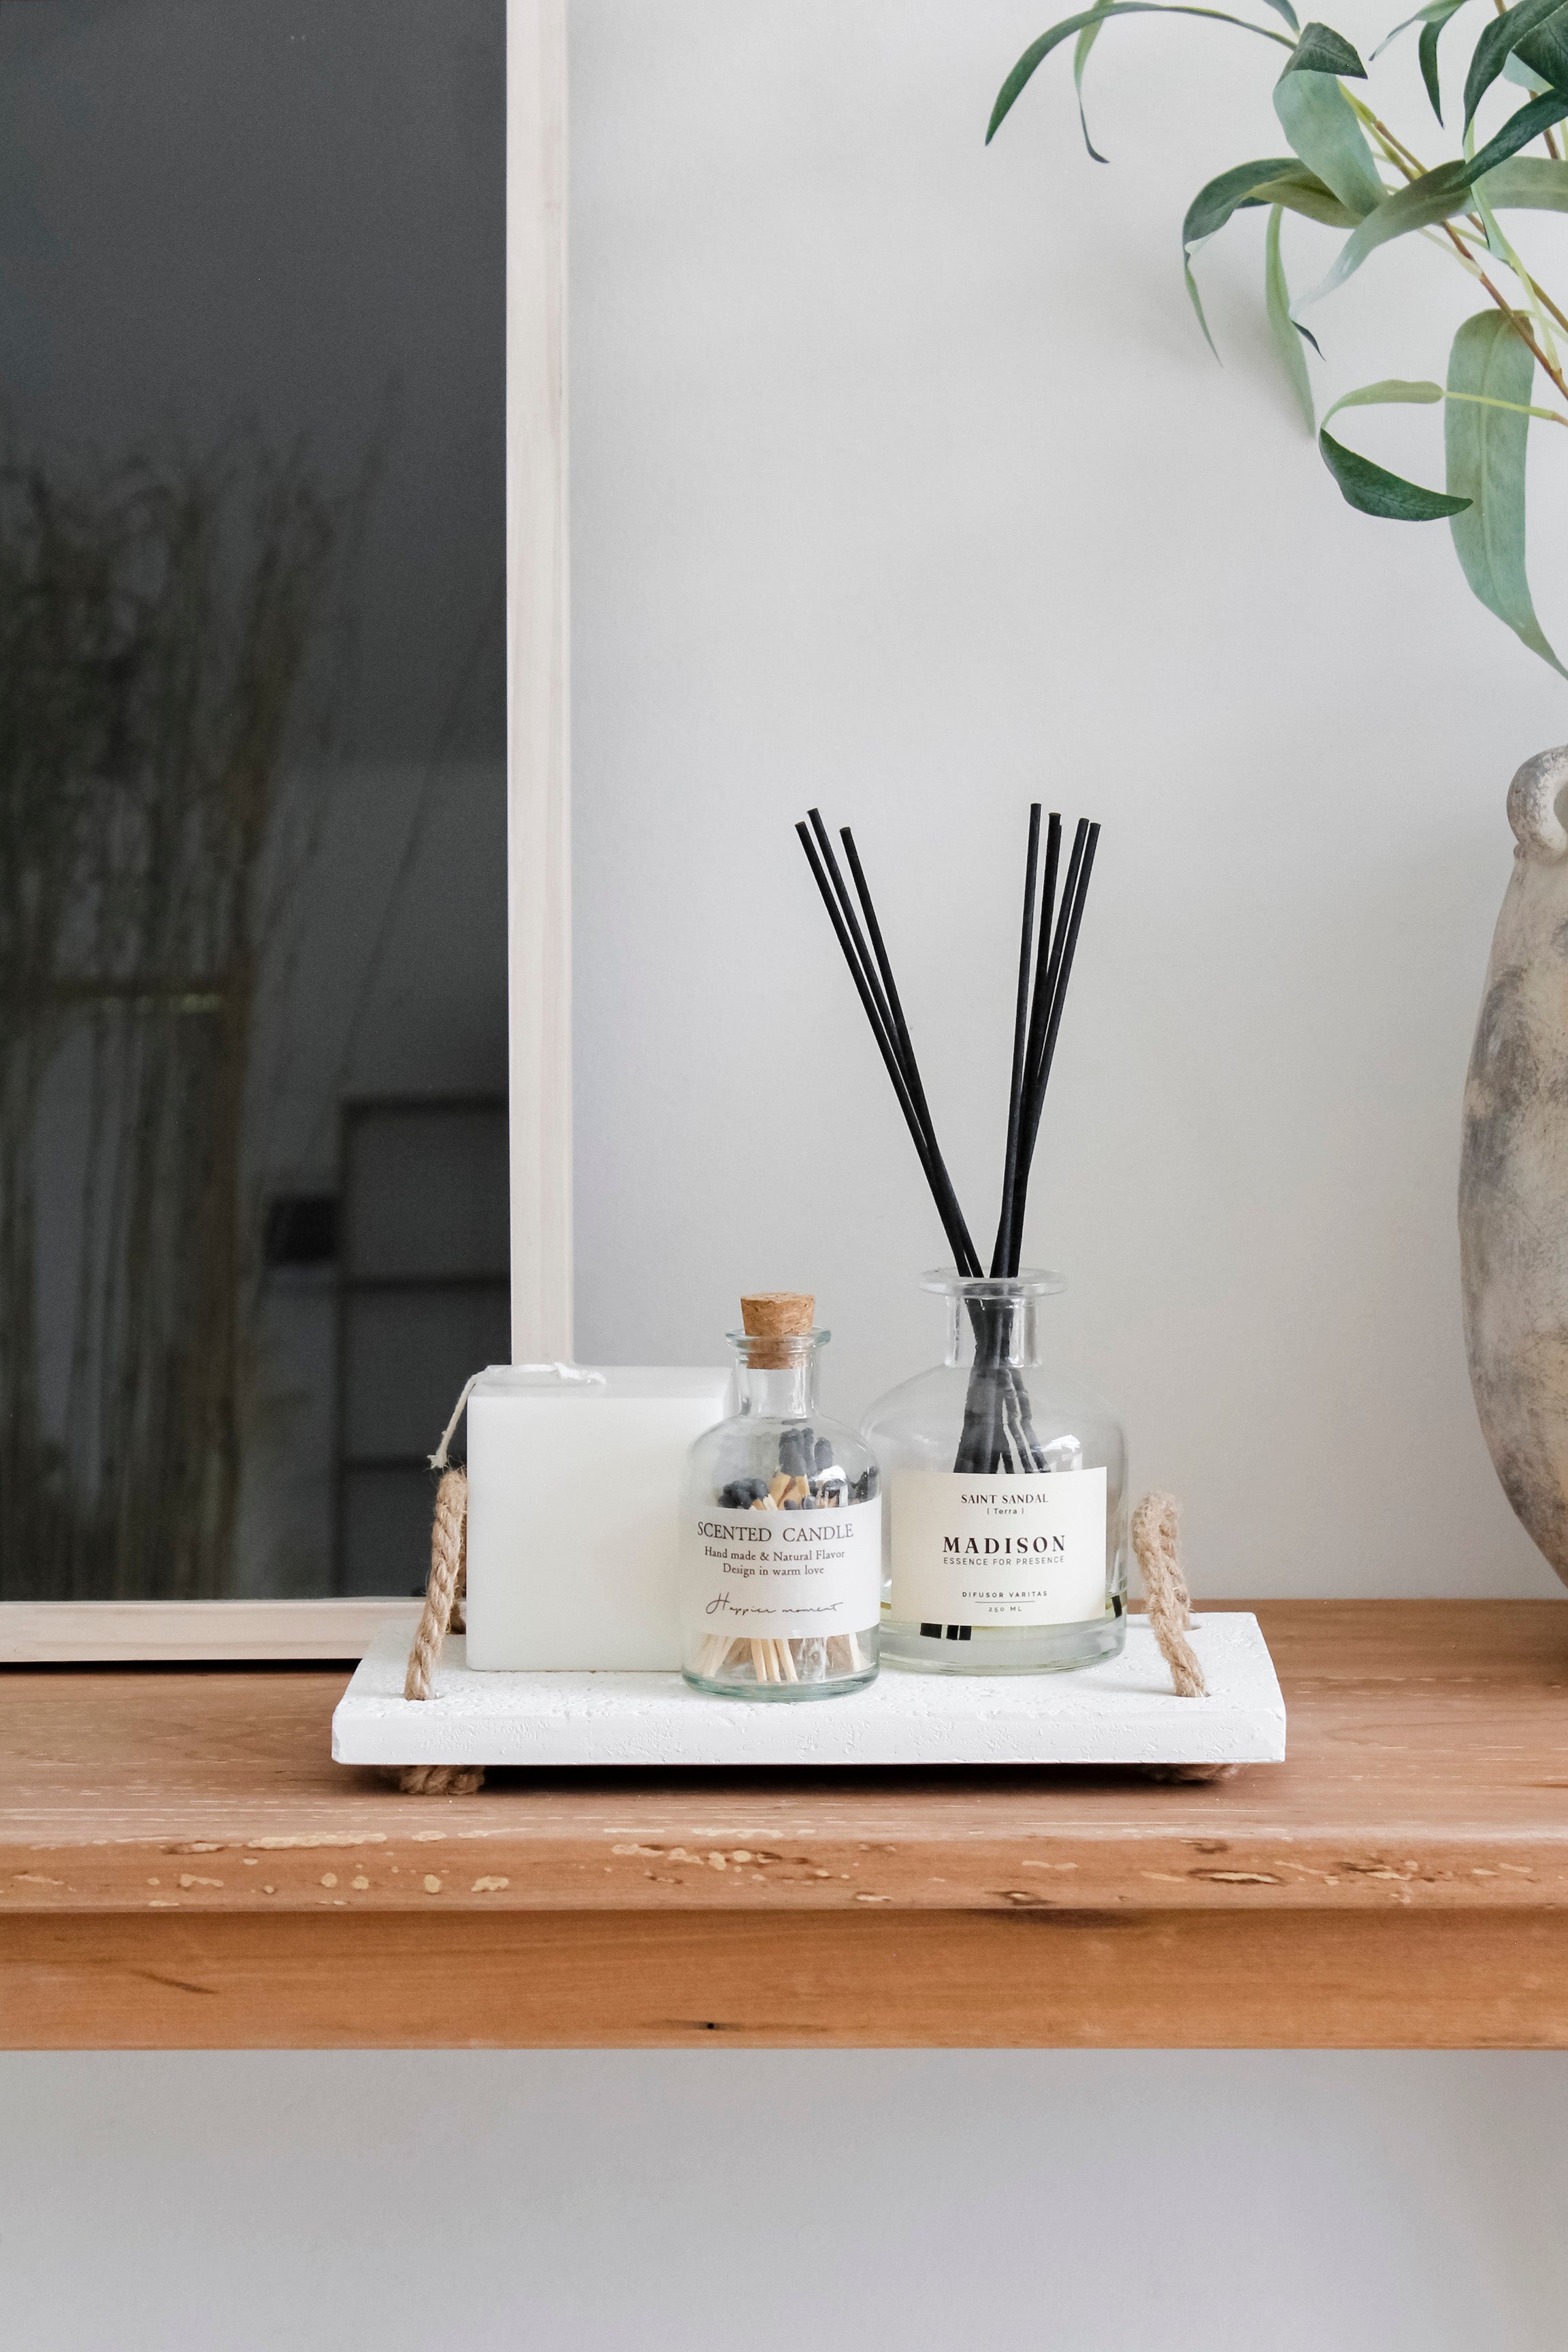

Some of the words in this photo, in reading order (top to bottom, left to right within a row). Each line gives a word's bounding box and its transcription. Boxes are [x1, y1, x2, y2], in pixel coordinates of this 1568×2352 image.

[961, 1494, 997, 1504] SAINT
[1002, 1494, 1049, 1504] SANDAL
[698, 1521, 772, 1542] SCENTED
[783, 1523, 854, 1542] CANDLE
[943, 1535, 1066, 1554] MADISON
[704, 1546, 728, 1558] Hand
[731, 1551, 756, 1561] made
[760, 1552, 769, 1561] &
[773, 1550, 812, 1561] Natural
[816, 1550, 845, 1560] Flavor
[943, 1557, 988, 1565] ESSENCE
[1016, 1556, 1064, 1565] PRESENCE
[723, 1563, 755, 1578] Design
[759, 1565, 769, 1575] in
[772, 1567, 801, 1575] warm
[804, 1565, 824, 1575] love
